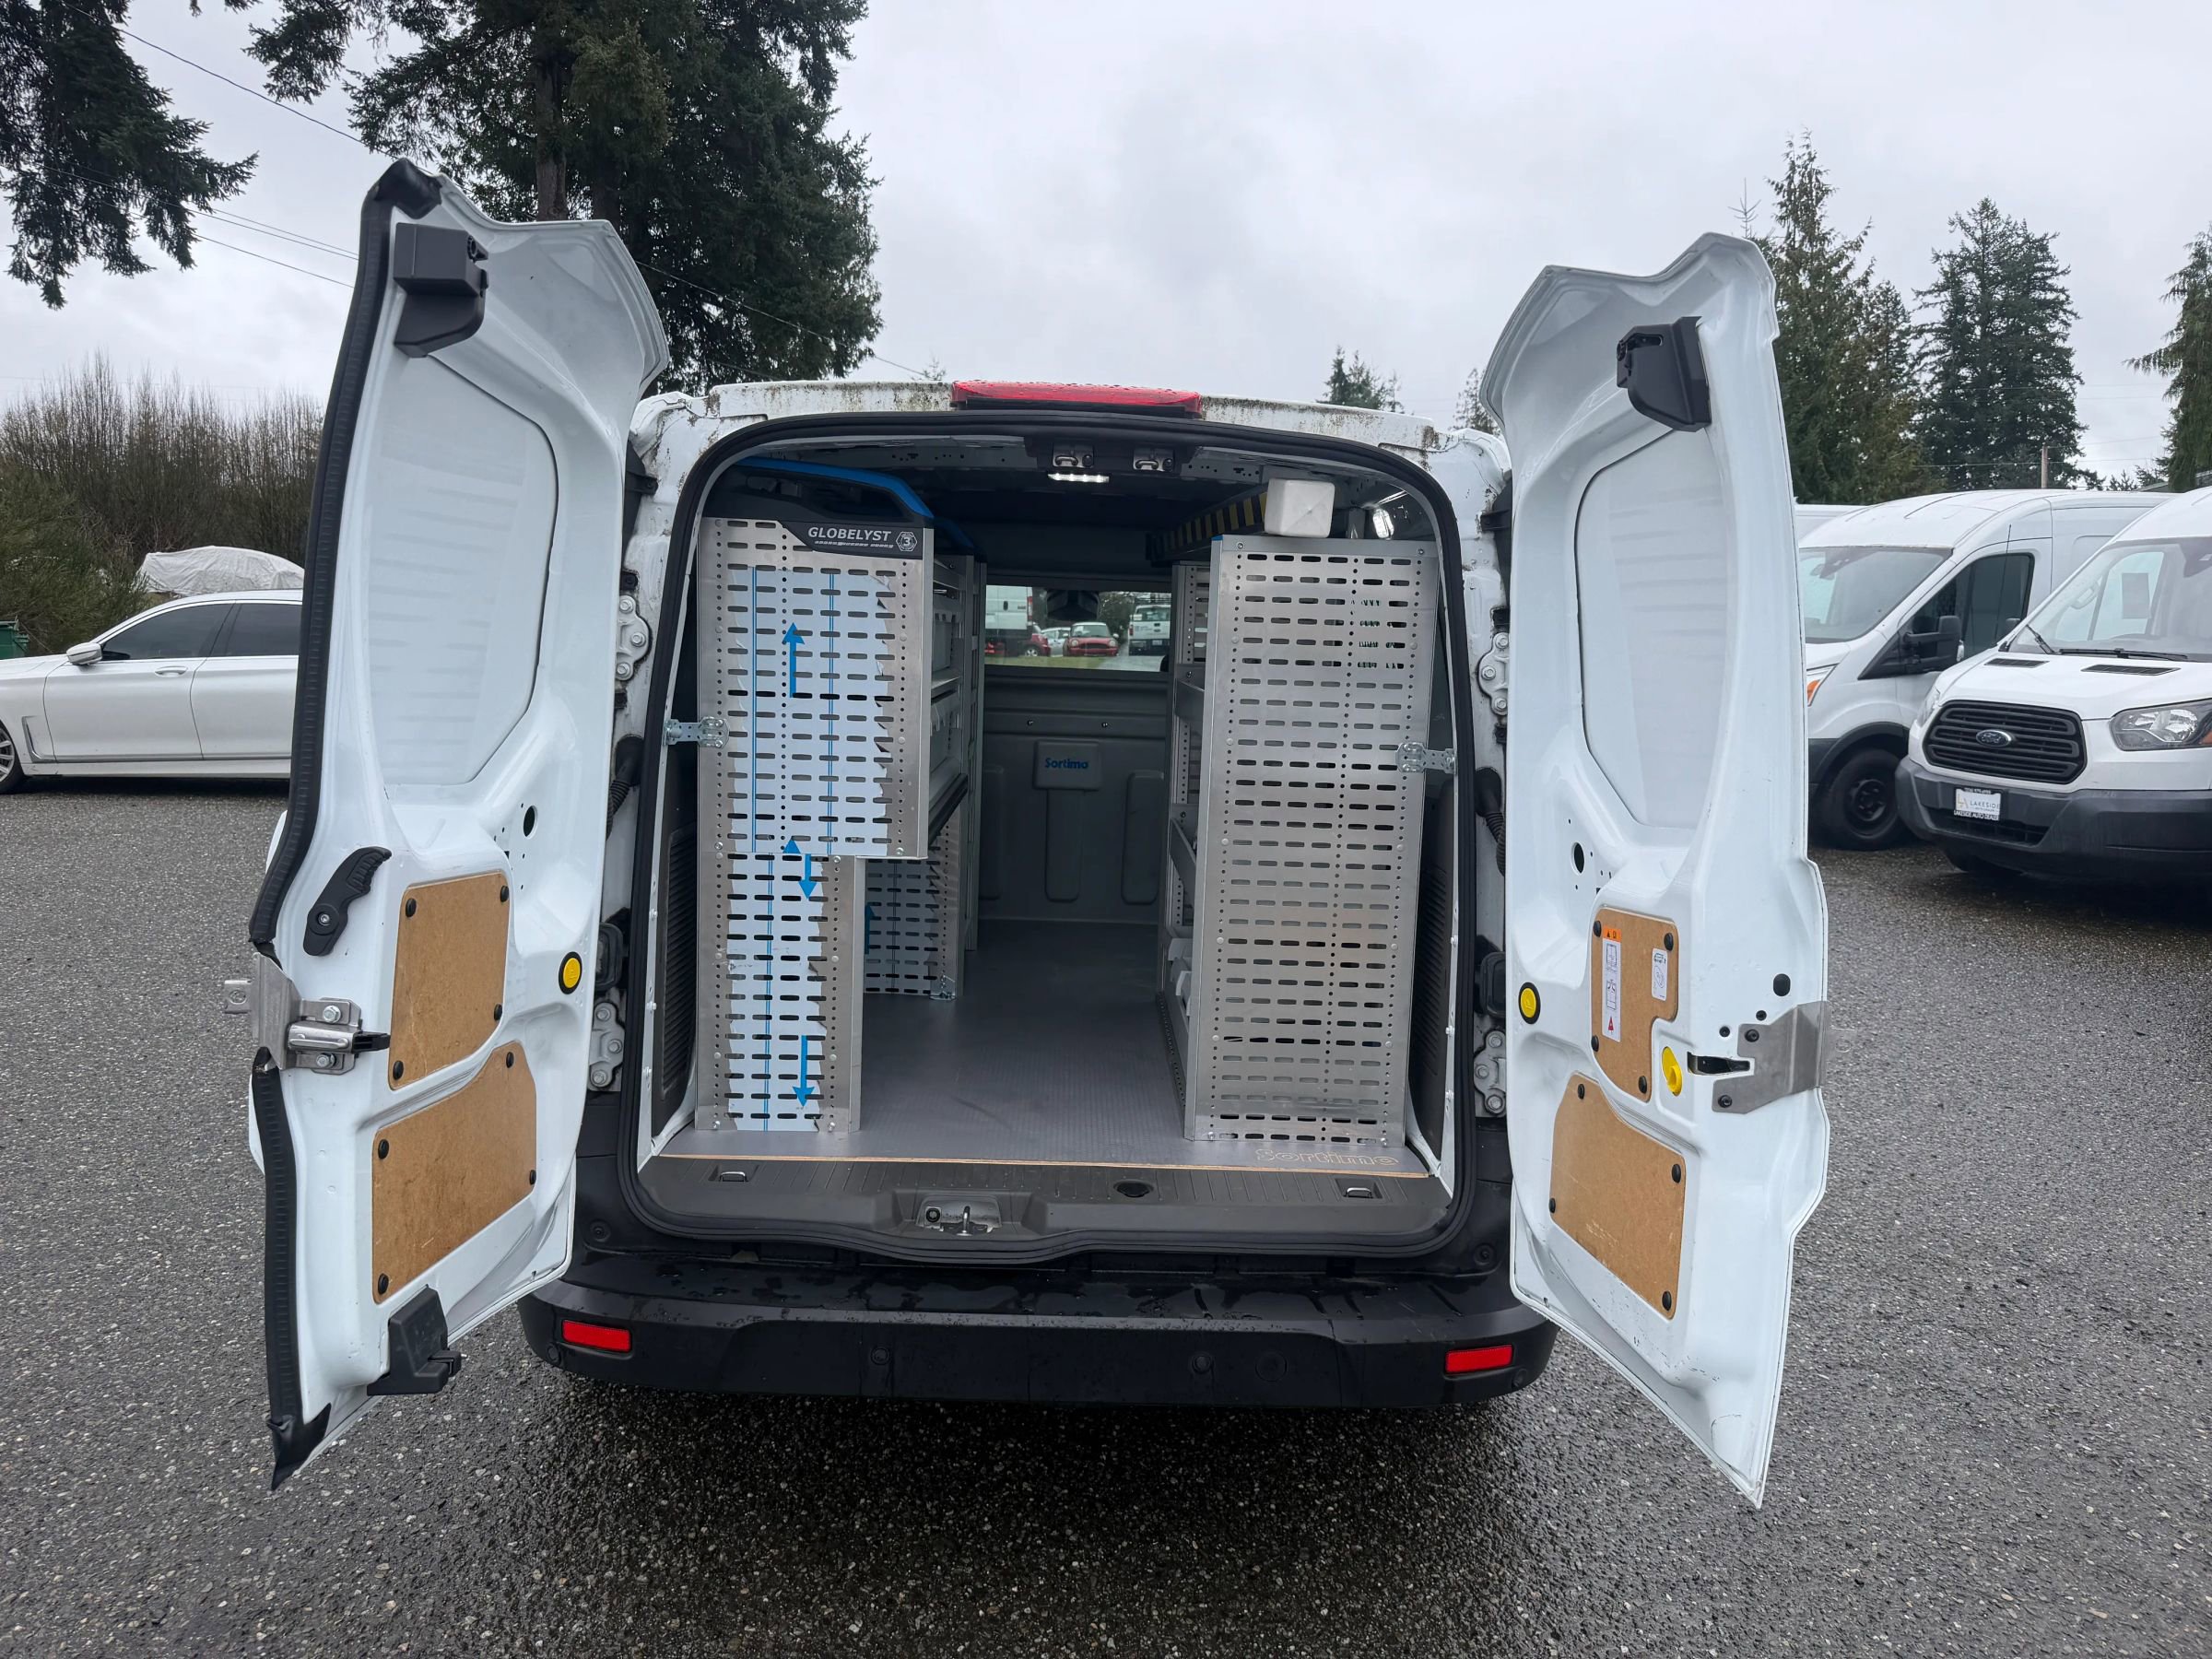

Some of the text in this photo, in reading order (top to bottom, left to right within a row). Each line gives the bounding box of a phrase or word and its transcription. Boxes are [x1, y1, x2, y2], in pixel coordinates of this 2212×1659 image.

[807, 526, 892, 542] GLOBELYST
[1044, 757, 1089, 769] Sortimo
[1254, 1148, 1400, 1166] Sortimo
